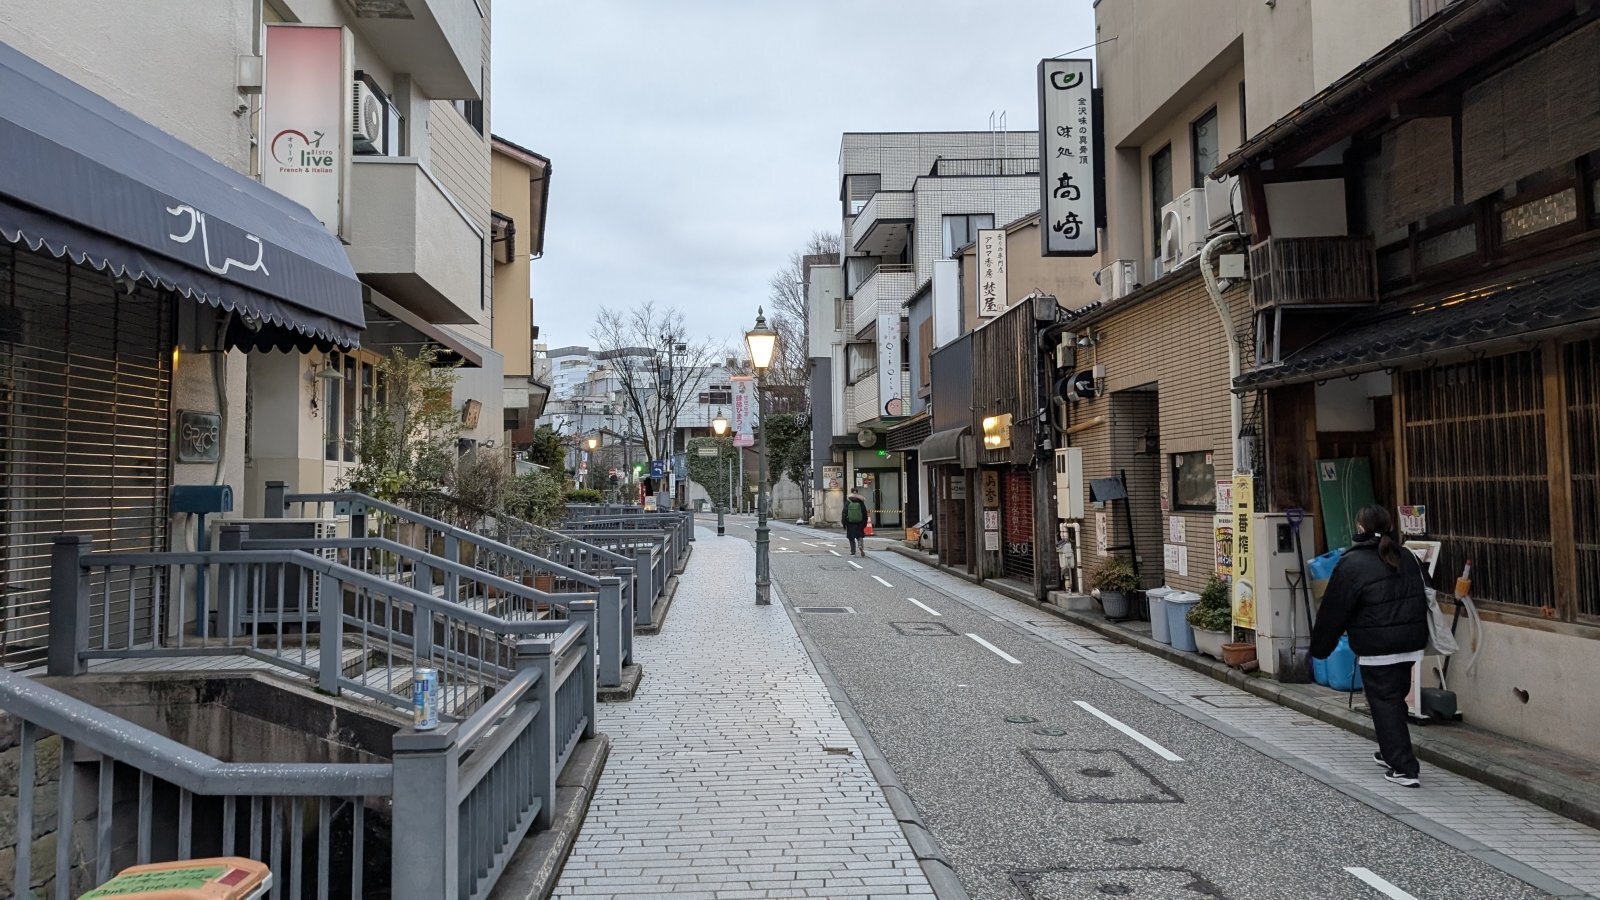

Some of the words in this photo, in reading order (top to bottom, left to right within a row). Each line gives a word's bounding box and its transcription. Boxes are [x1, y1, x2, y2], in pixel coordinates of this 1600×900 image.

[1078, 97, 1088, 165] 金沢味の真骨頂
[1238, 502, 1249, 576] 一番搾り
